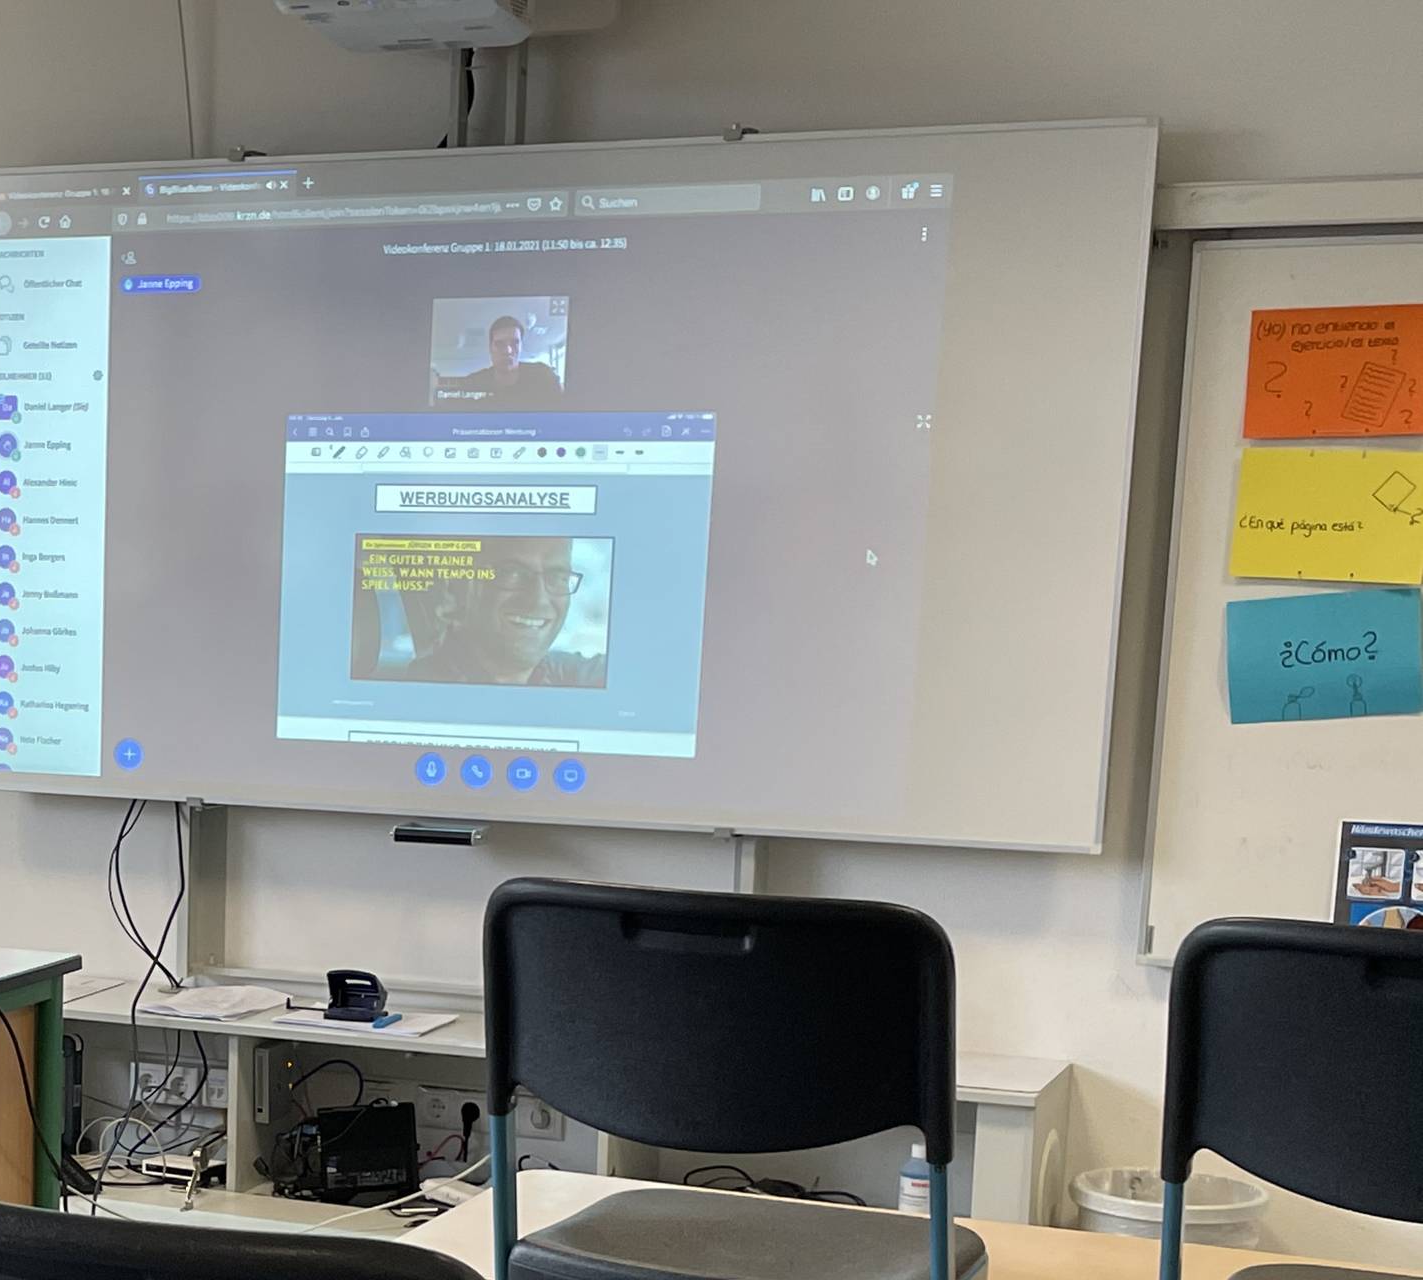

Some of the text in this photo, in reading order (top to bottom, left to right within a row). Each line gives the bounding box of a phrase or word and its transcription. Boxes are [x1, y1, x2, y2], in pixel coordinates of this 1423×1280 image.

[597, 197, 638, 210] Suchen
[383, 242, 449, 254] Videokonferenz
[450, 242, 483, 254] Gruppe
[494, 240, 540, 252] 18.01.2021
[570, 239, 583, 249] bis
[164, 278, 194, 290] Epping
[1291, 323, 1312, 336] no
[399, 491, 571, 508] WERBUNGSANALYSE
[1265, 514, 1285, 532] qué
[1290, 518, 1328, 538] página
[388, 554, 426, 566] GUTER
[427, 555, 474, 567] TRAINER
[399, 567, 434, 579] WANN
[437, 568, 475, 580] TEMPO
[476, 569, 498, 580] INS
[361, 578, 392, 591] SPIEL
[1279, 630, 1378, 668] ¿Cómo?
